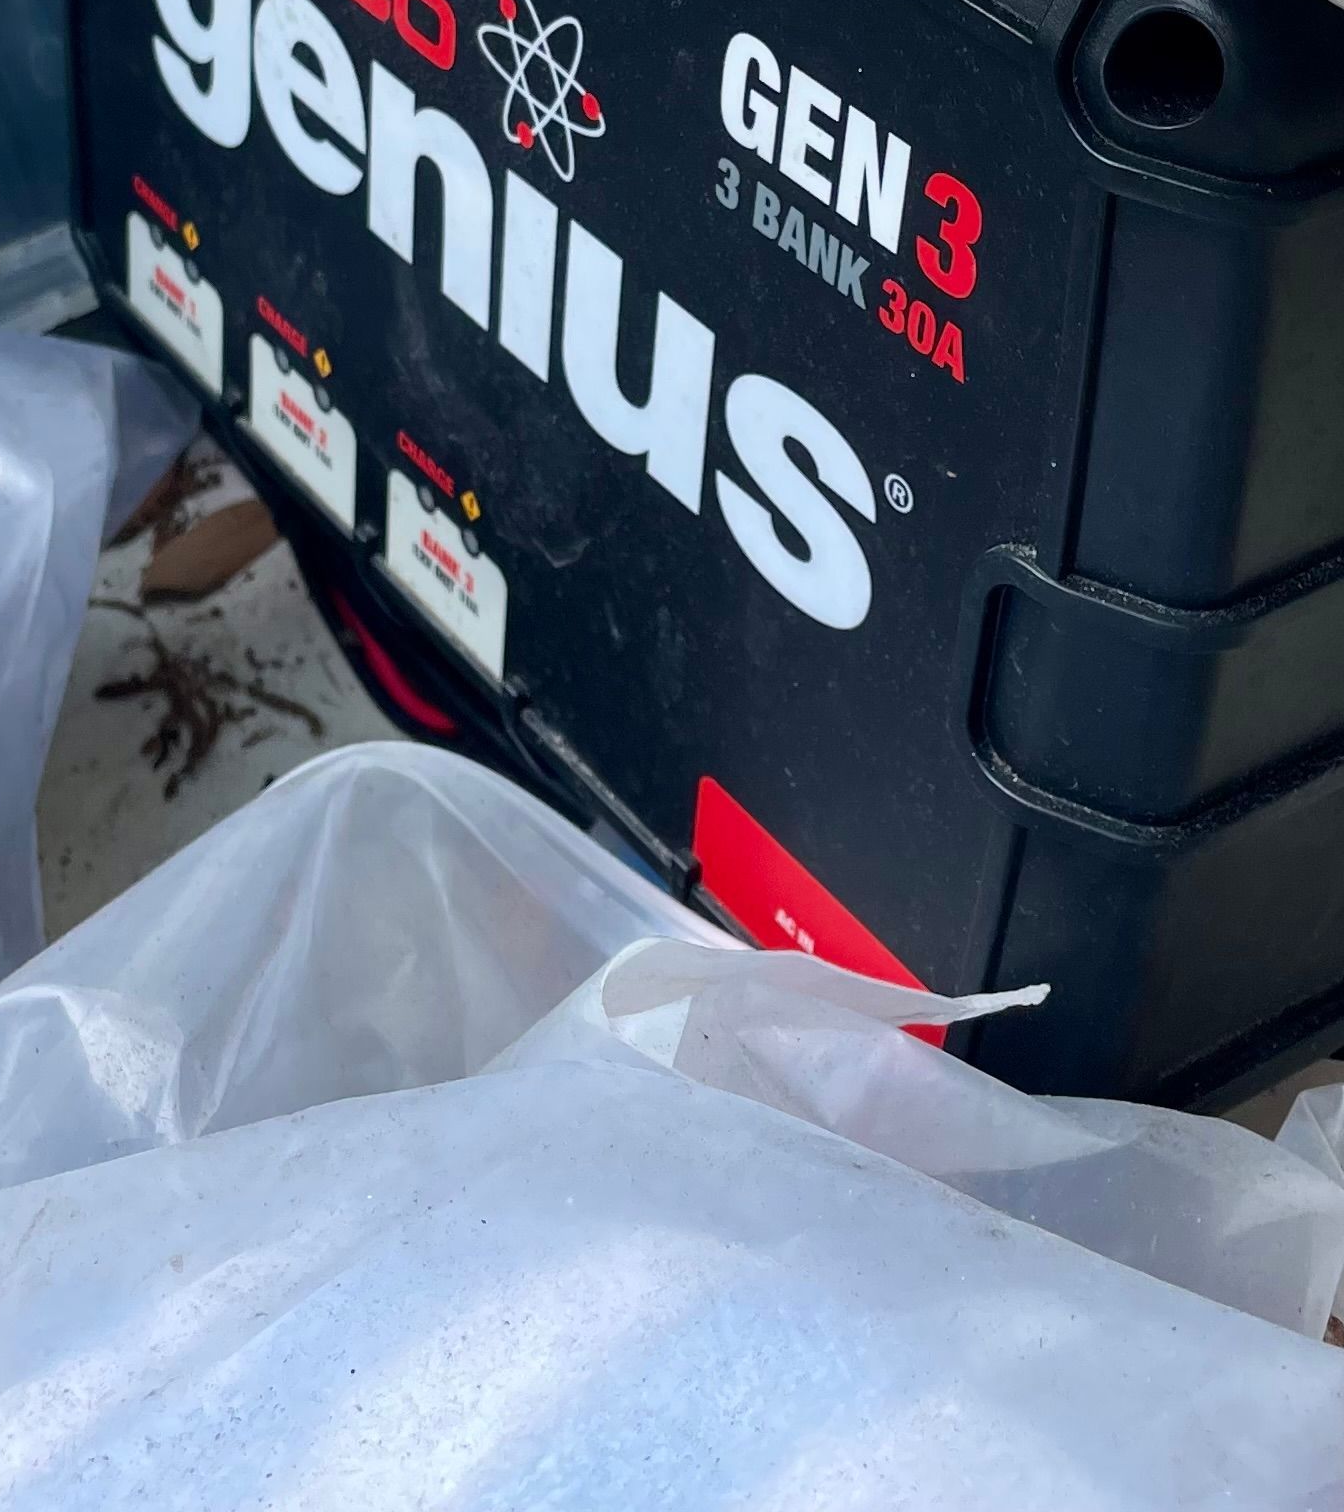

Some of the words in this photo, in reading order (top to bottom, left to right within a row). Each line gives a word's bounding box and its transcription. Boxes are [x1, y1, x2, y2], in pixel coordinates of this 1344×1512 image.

[720, 33, 912, 254] GEN
[916, 172, 983, 300] 3
[258, 295, 308, 358] CHARGE
[715, 157, 741, 214] 3
[752, 181, 870, 311] BANK
[878, 279, 966, 385] 30A
[398, 429, 455, 498] CHARGE
